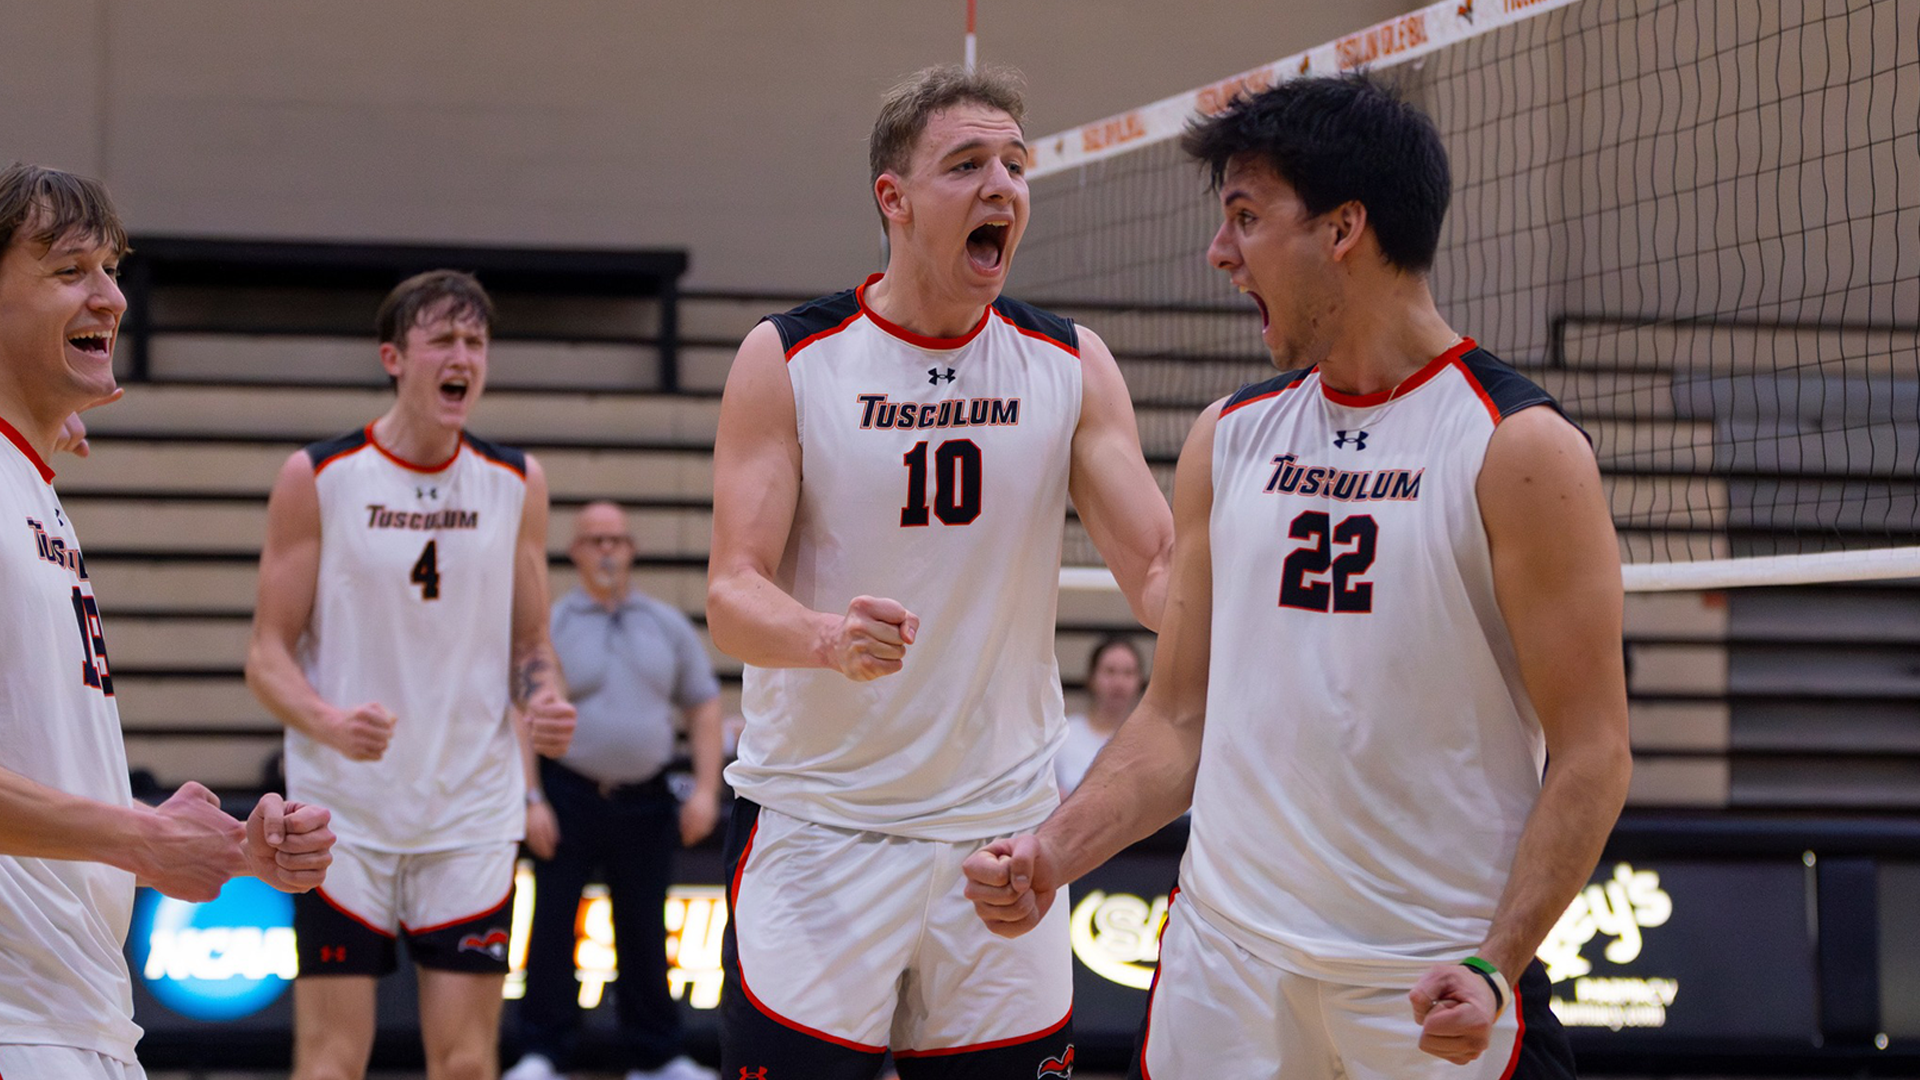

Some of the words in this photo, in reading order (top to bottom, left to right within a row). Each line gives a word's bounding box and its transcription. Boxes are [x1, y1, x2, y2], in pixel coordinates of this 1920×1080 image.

[857, 394, 1020, 430] TUSCULUM
[900, 438, 982, 527] 10
[410, 538, 441, 601] 4
[1278, 510, 1379, 613] 22
[71, 585, 115, 697] 19
